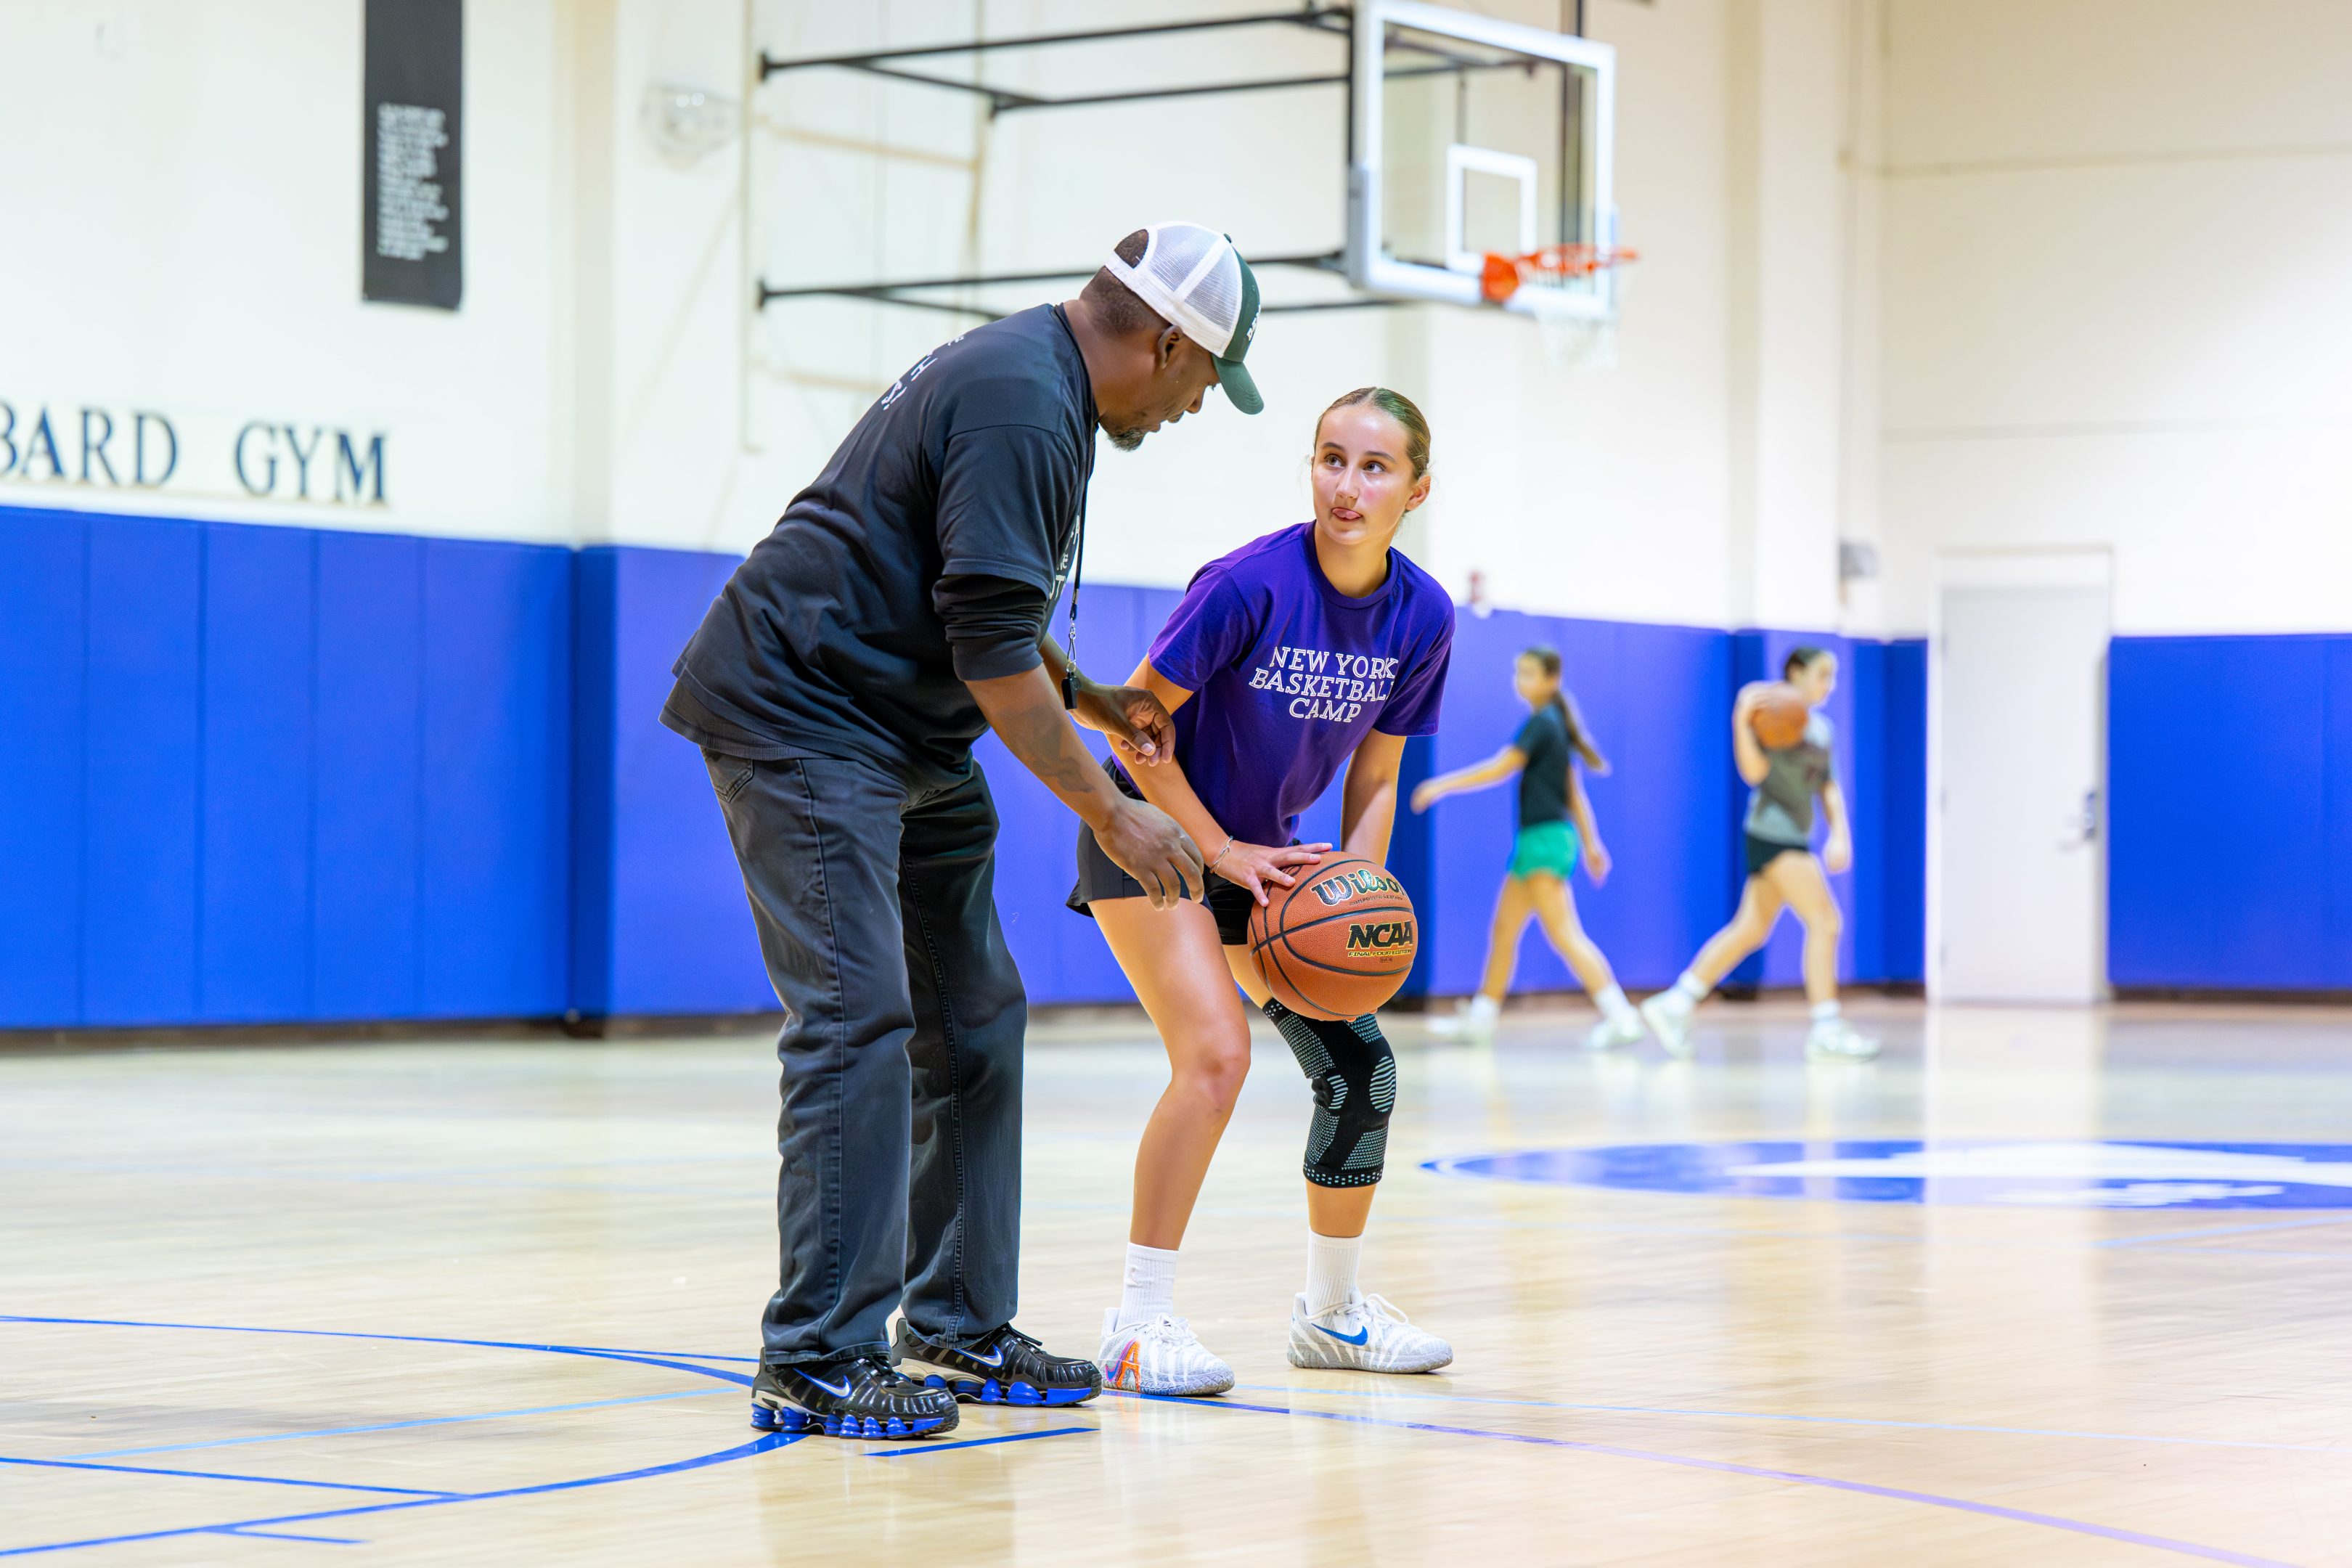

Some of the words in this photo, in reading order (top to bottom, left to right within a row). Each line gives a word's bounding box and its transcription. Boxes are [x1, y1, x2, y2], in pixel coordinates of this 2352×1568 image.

[234, 420, 389, 502] GYM
[1270, 646, 1329, 674] NEW
[1336, 653, 1399, 679] YORK
[1289, 698, 1361, 723] CAMP
[1346, 920, 1413, 950] NCAA
